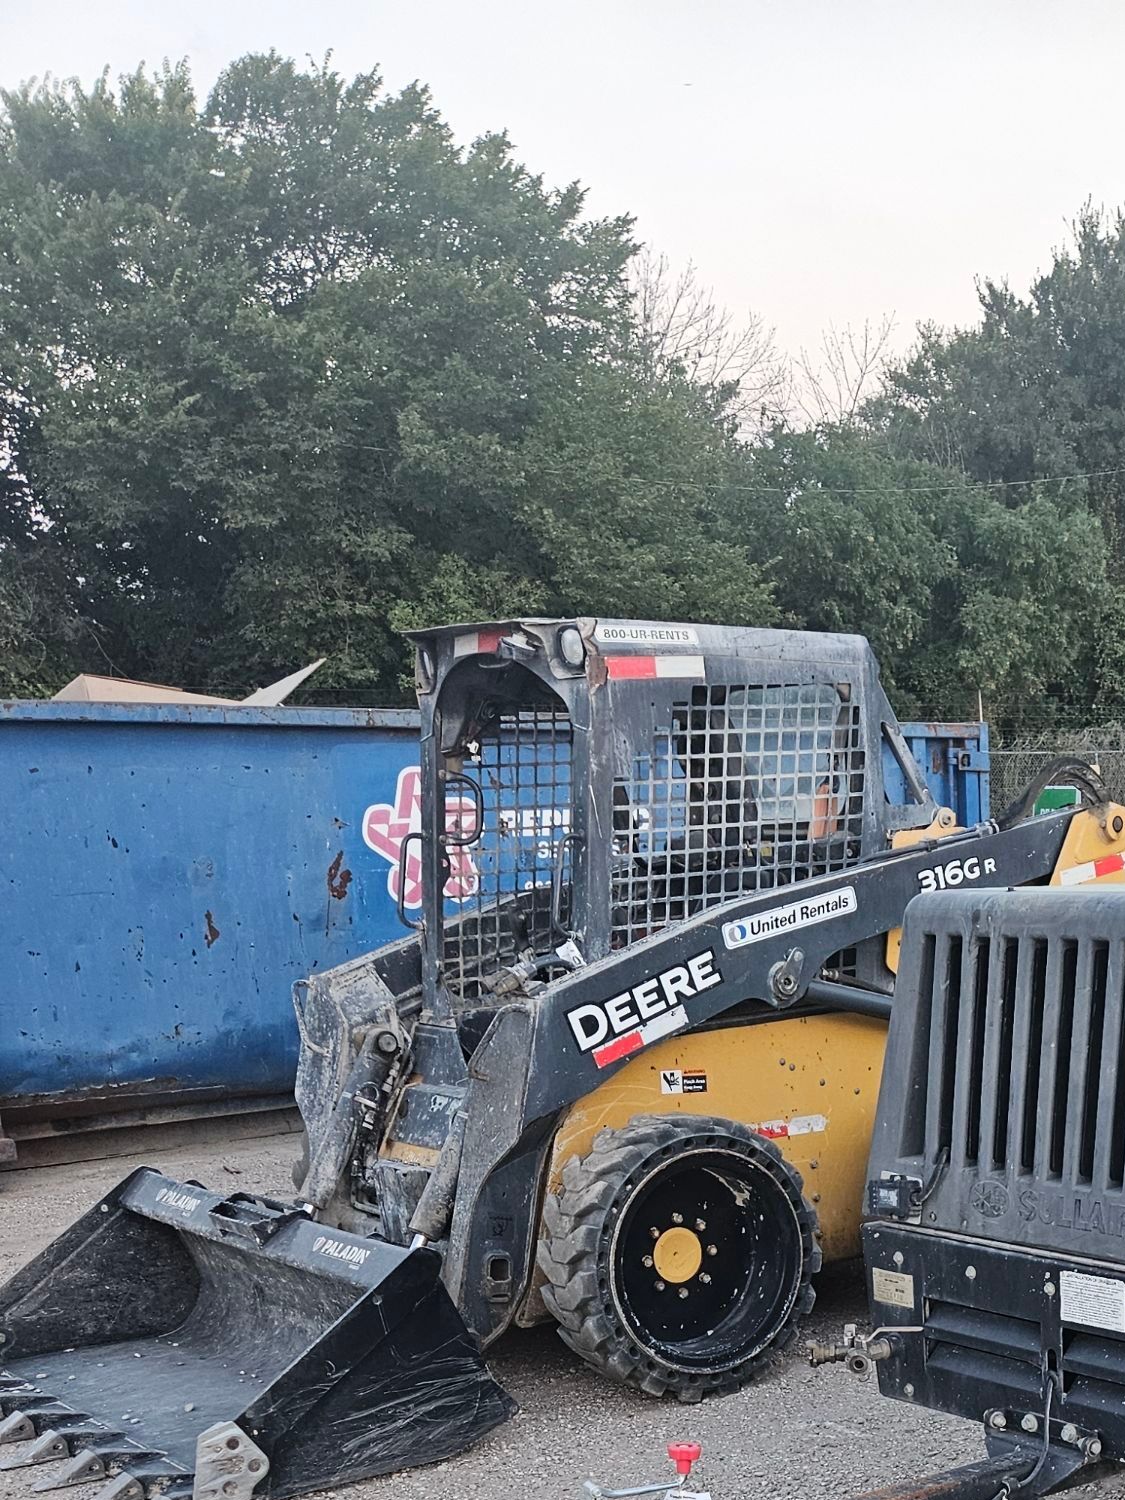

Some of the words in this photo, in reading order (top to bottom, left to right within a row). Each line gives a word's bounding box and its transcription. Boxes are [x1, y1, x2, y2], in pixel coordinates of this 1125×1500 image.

[603, 628, 690, 640] 800-UR-RENTS
[918, 857, 981, 893] 316G
[984, 857, 998, 875] R
[750, 909, 796, 936] United
[801, 895, 849, 921] Rentals
[567, 950, 722, 1052] DEERE
[161, 1190, 202, 1212] PALADIN
[321, 1239, 371, 1264] PALADIN
